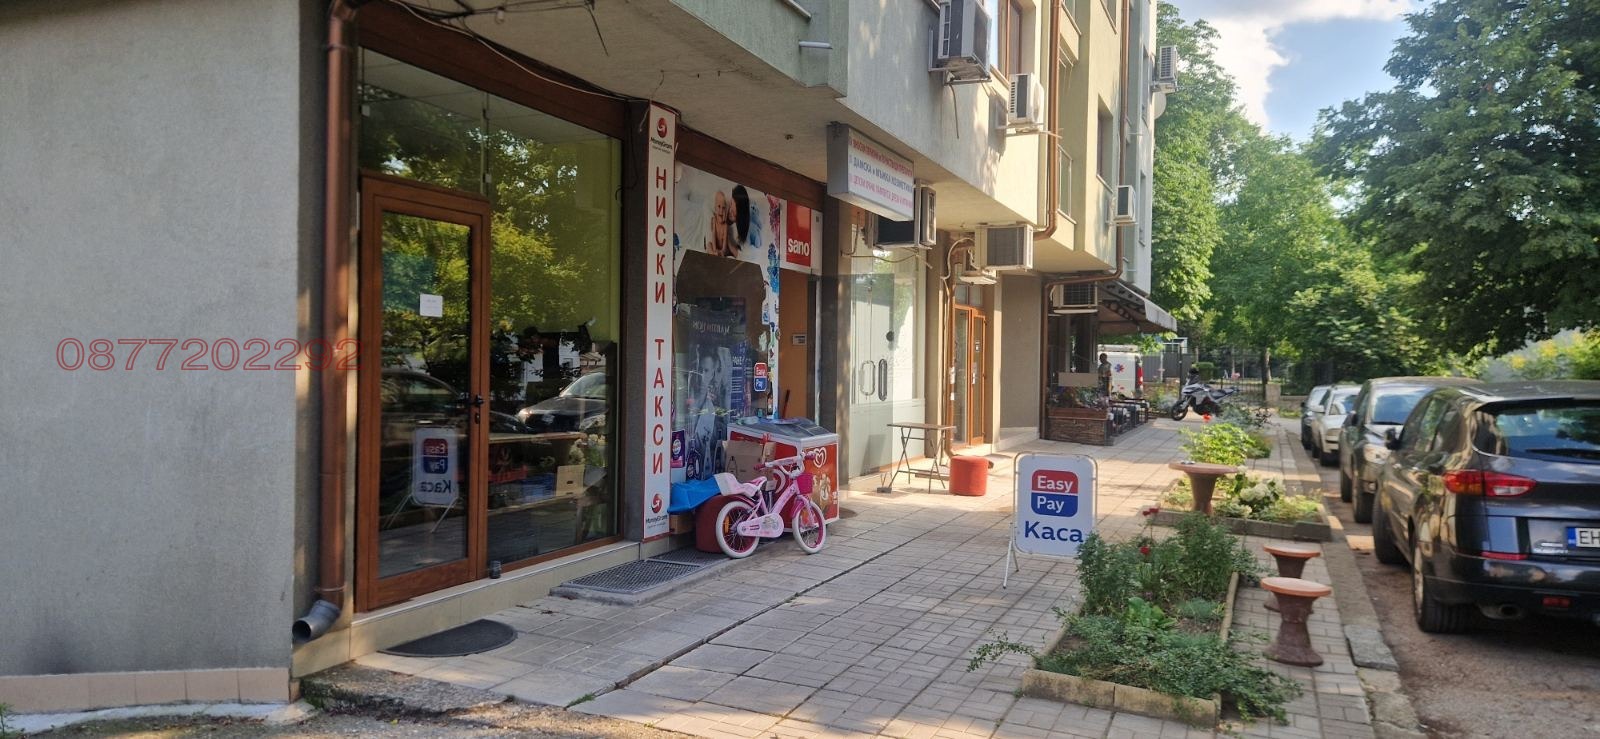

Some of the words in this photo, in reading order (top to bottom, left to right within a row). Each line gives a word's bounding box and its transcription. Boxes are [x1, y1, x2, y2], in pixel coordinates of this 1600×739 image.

[853, 157, 872, 174] ДАМСКА
[655, 166, 667, 304] НИСКИ
[787, 238, 810, 257] sano
[652, 338, 665, 475] ТАКСИ
[1037, 475, 1074, 493] Easy
[1036, 495, 1065, 513] Pay
[1024, 520, 1084, 543] Каса
